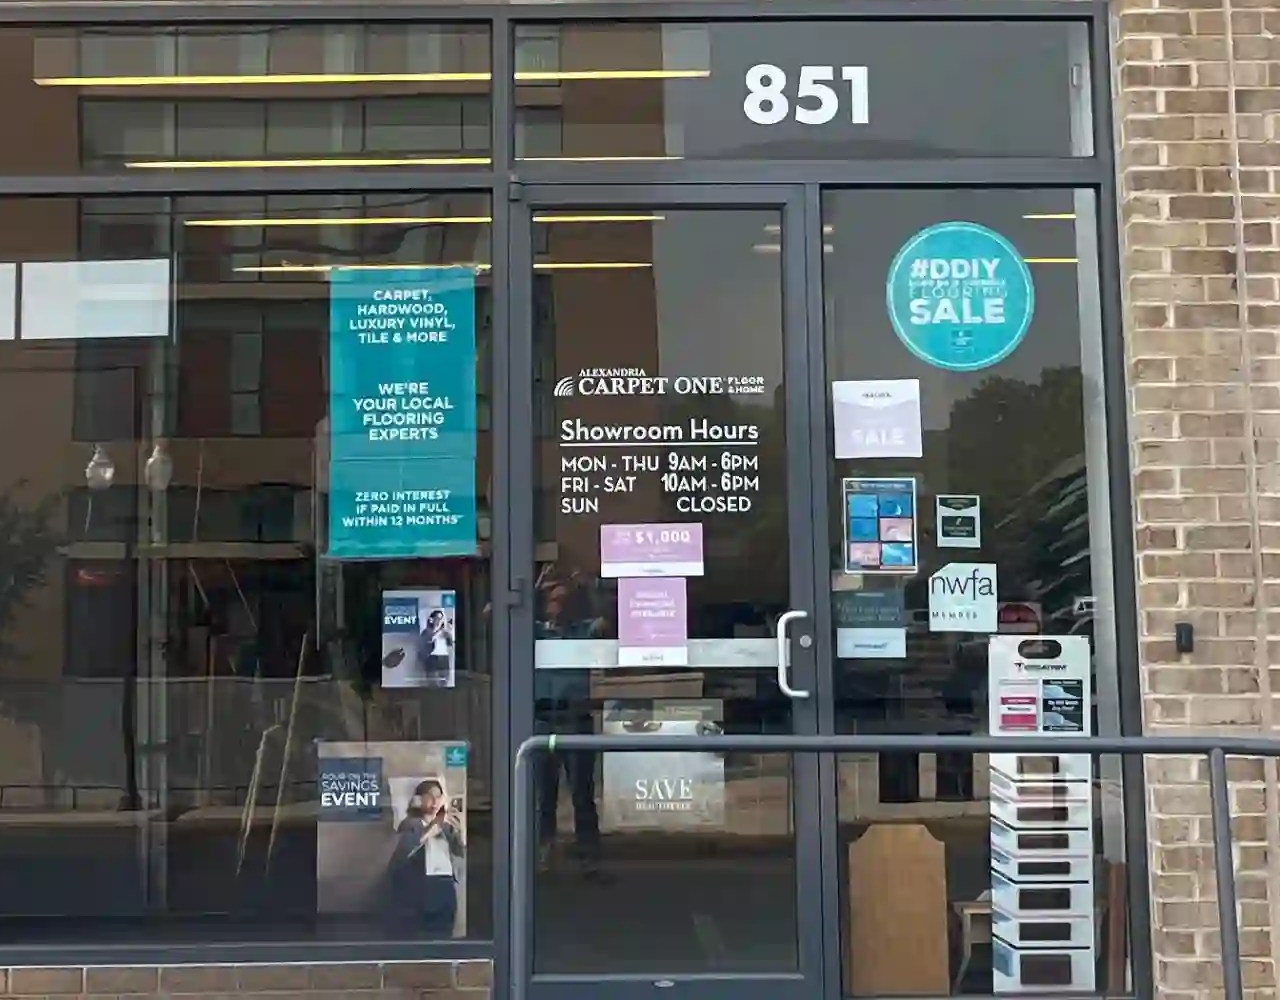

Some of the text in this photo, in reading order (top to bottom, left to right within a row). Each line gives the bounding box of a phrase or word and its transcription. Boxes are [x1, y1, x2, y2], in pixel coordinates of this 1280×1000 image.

[743, 63, 869, 125] 851
[910, 258, 1001, 279] #DDIY
[373, 288, 432, 302] CARPET,
[357, 303, 448, 316] HARDWOOD,
[909, 298, 1006, 325] SALE
[349, 316, 456, 330] LUXURY VINYL,
[357, 331, 447, 344] TILE & MORE
[578, 368, 646, 377] ALEXANDRIA
[578, 376, 723, 396] CARPET ONE
[727, 376, 765, 385] FLOOR
[378, 382, 429, 396] WE'RE
[352, 396, 454, 411] YOUR LOCAL
[363, 411, 445, 426] FLOORING
[368, 427, 439, 441] EXPERTS
[560, 418, 759, 440] Showroom Hours
[561, 455, 607, 472] MON
[621, 455, 659, 471] THU
[668, 452, 707, 471] 9AM
[721, 451, 758, 470] 6PM
[561, 476, 589, 493] FRI
[603, 476, 637, 492] SAT
[660, 473, 707, 492] 10AM
[721, 472, 759, 491] 6PM
[355, 489, 451, 502] ZERO INTEREST
[356, 502, 449, 515] IF PAID IN FULL
[561, 497, 751, 514] SUN CLOSED
[342, 515, 387, 527] WITHIN
[391, 515, 403, 527] 12
[635, 530, 691, 545] $1,000
[931, 568, 995, 601] nwfa
[384, 615, 417, 625] EVENT
[321, 780, 379, 792] SAVINGS
[635, 778, 693, 800] SAVE
[321, 791, 380, 807] EVENT
